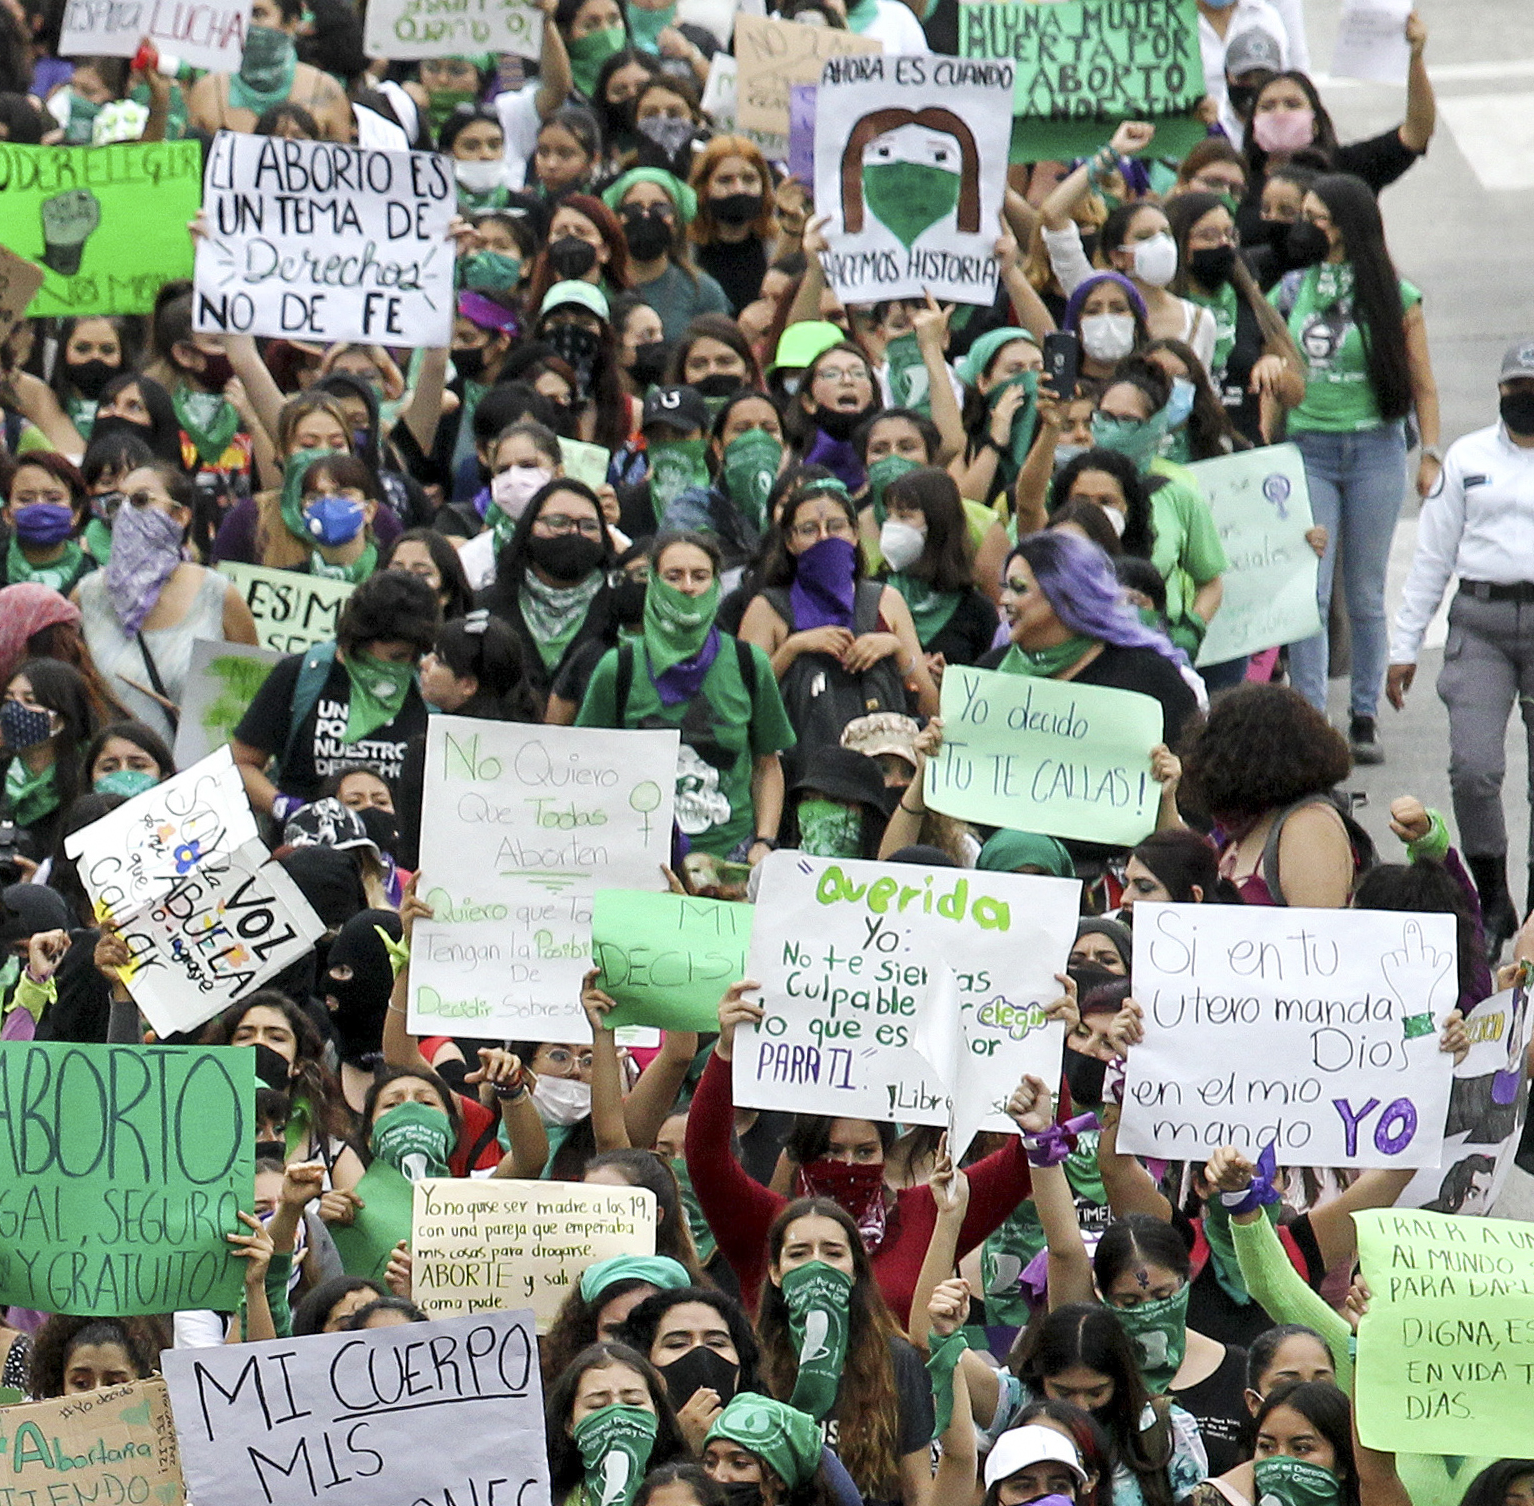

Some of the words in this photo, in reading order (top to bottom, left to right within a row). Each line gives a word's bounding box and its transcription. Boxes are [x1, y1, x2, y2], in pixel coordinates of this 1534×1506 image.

[821, 58, 884, 85] AHORA
[896, 56, 925, 84] ES
[934, 60, 1014, 90] CUANDO
[1028, 62, 1187, 101] ABORTO
[218, 201, 271, 236] UN
[278, 201, 363, 237] TEMA
[385, 201, 431, 241] DE
[199, 294, 256, 336] NO
[280, 295, 327, 333] DE
[363, 292, 403, 335] FE
[962, 676, 993, 724] Yo
[1007, 697, 1091, 737] decido
[441, 730, 503, 786] No
[513, 741, 620, 789] Quiero
[457, 800, 513, 825] Que
[524, 797, 609, 827] Todas
[494, 836, 609, 868] Aborten
[225, 876, 297, 962] VOZ
[679, 900, 735, 935] MI
[782, 942, 815, 970] No
[820, 946, 865, 976] te
[1148, 908, 1200, 970] Si
[1229, 937, 1286, 979] en
[1291, 928, 1339, 977] tu
[786, 972, 916, 1018] Culpable
[1310, 1026, 1413, 1074] Dios
[1152, 1112, 1312, 1150] mando
[1330, 1097, 1419, 1159] YO
[98, 1189, 240, 1246] SEGURO
[418, 1225, 444, 1237] con
[451, 1226, 478, 1238] una
[485, 1223, 527, 1242] pareja
[533, 1223, 557, 1243] que
[564, 1218, 634, 1235] empeñaba
[418, 1247, 444, 1259] mis
[449, 1247, 486, 1259] cosas
[491, 1247, 523, 1264] para
[1392, 1244, 1420, 1269] AL
[1428, 1249, 1515, 1275] MUNDO
[194, 1350, 313, 1442] MI
[330, 1324, 533, 1411] CUERPO
[1406, 1361, 1443, 1385] EN
[1456, 1363, 1508, 1383] VIDA
[248, 1421, 383, 1504] MIS
